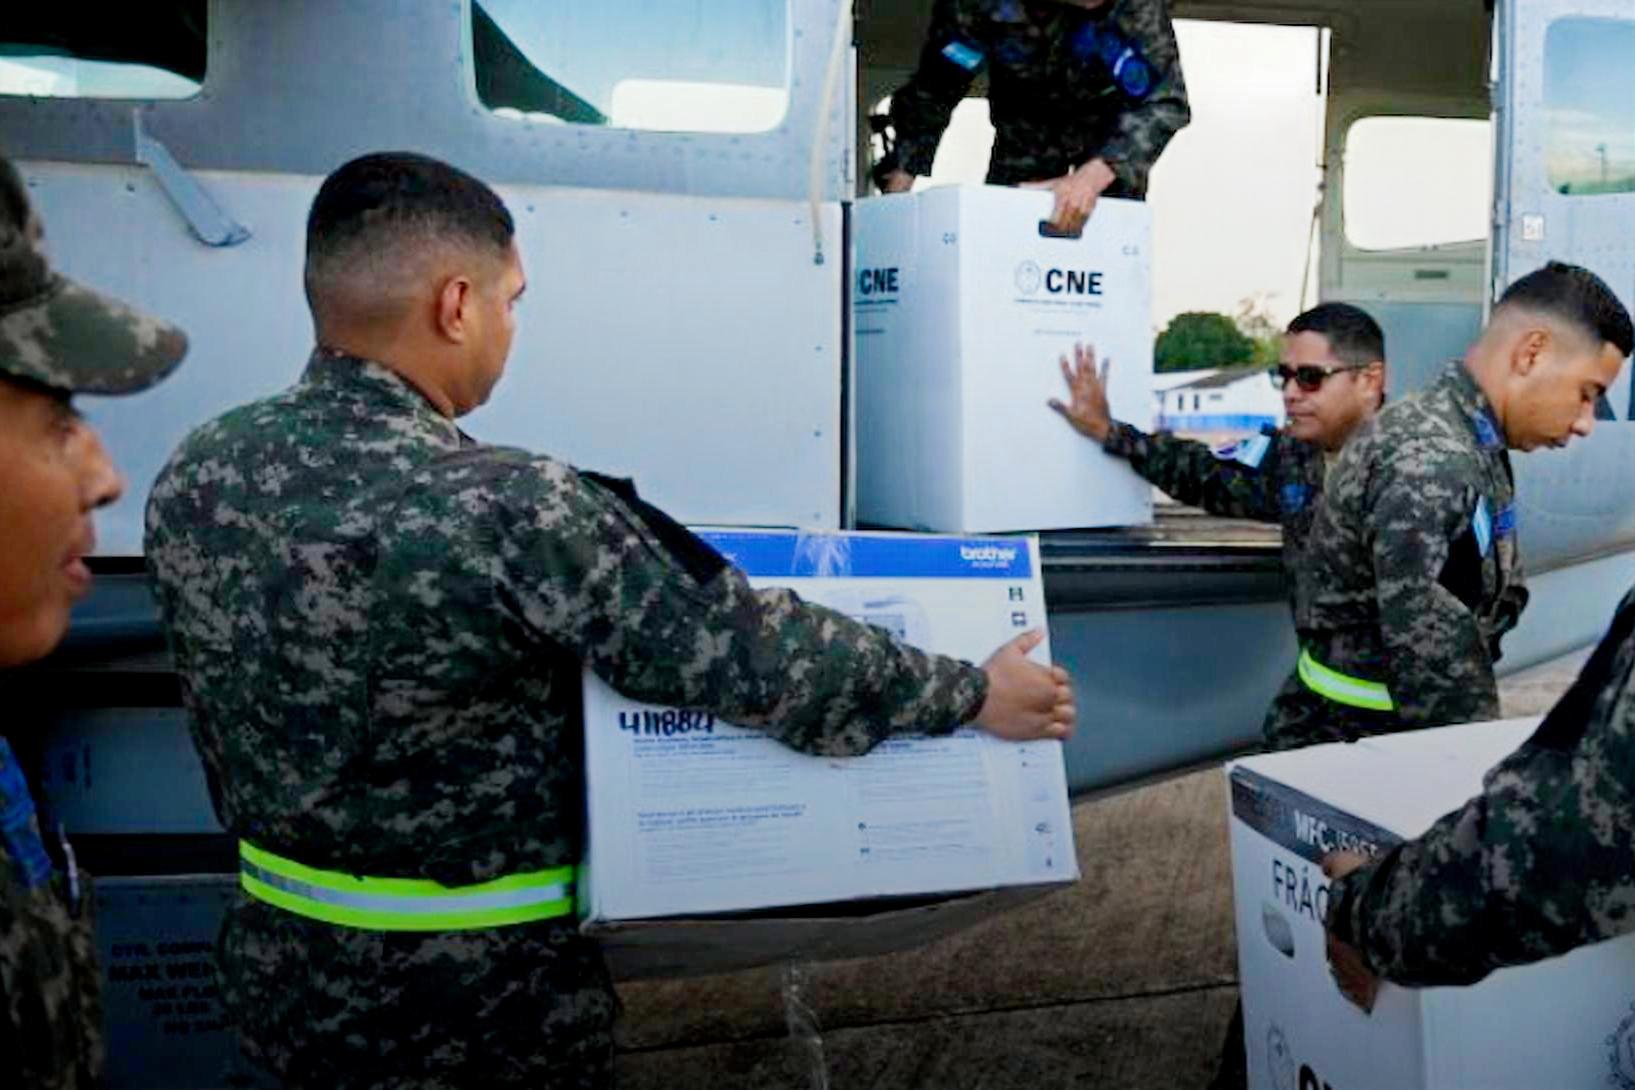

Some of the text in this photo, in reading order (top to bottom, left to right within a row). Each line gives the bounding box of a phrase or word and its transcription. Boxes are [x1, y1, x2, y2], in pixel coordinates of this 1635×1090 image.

[860, 267, 899, 295] CNE
[1046, 268, 1103, 295] CNE
[960, 545, 1016, 561] brother
